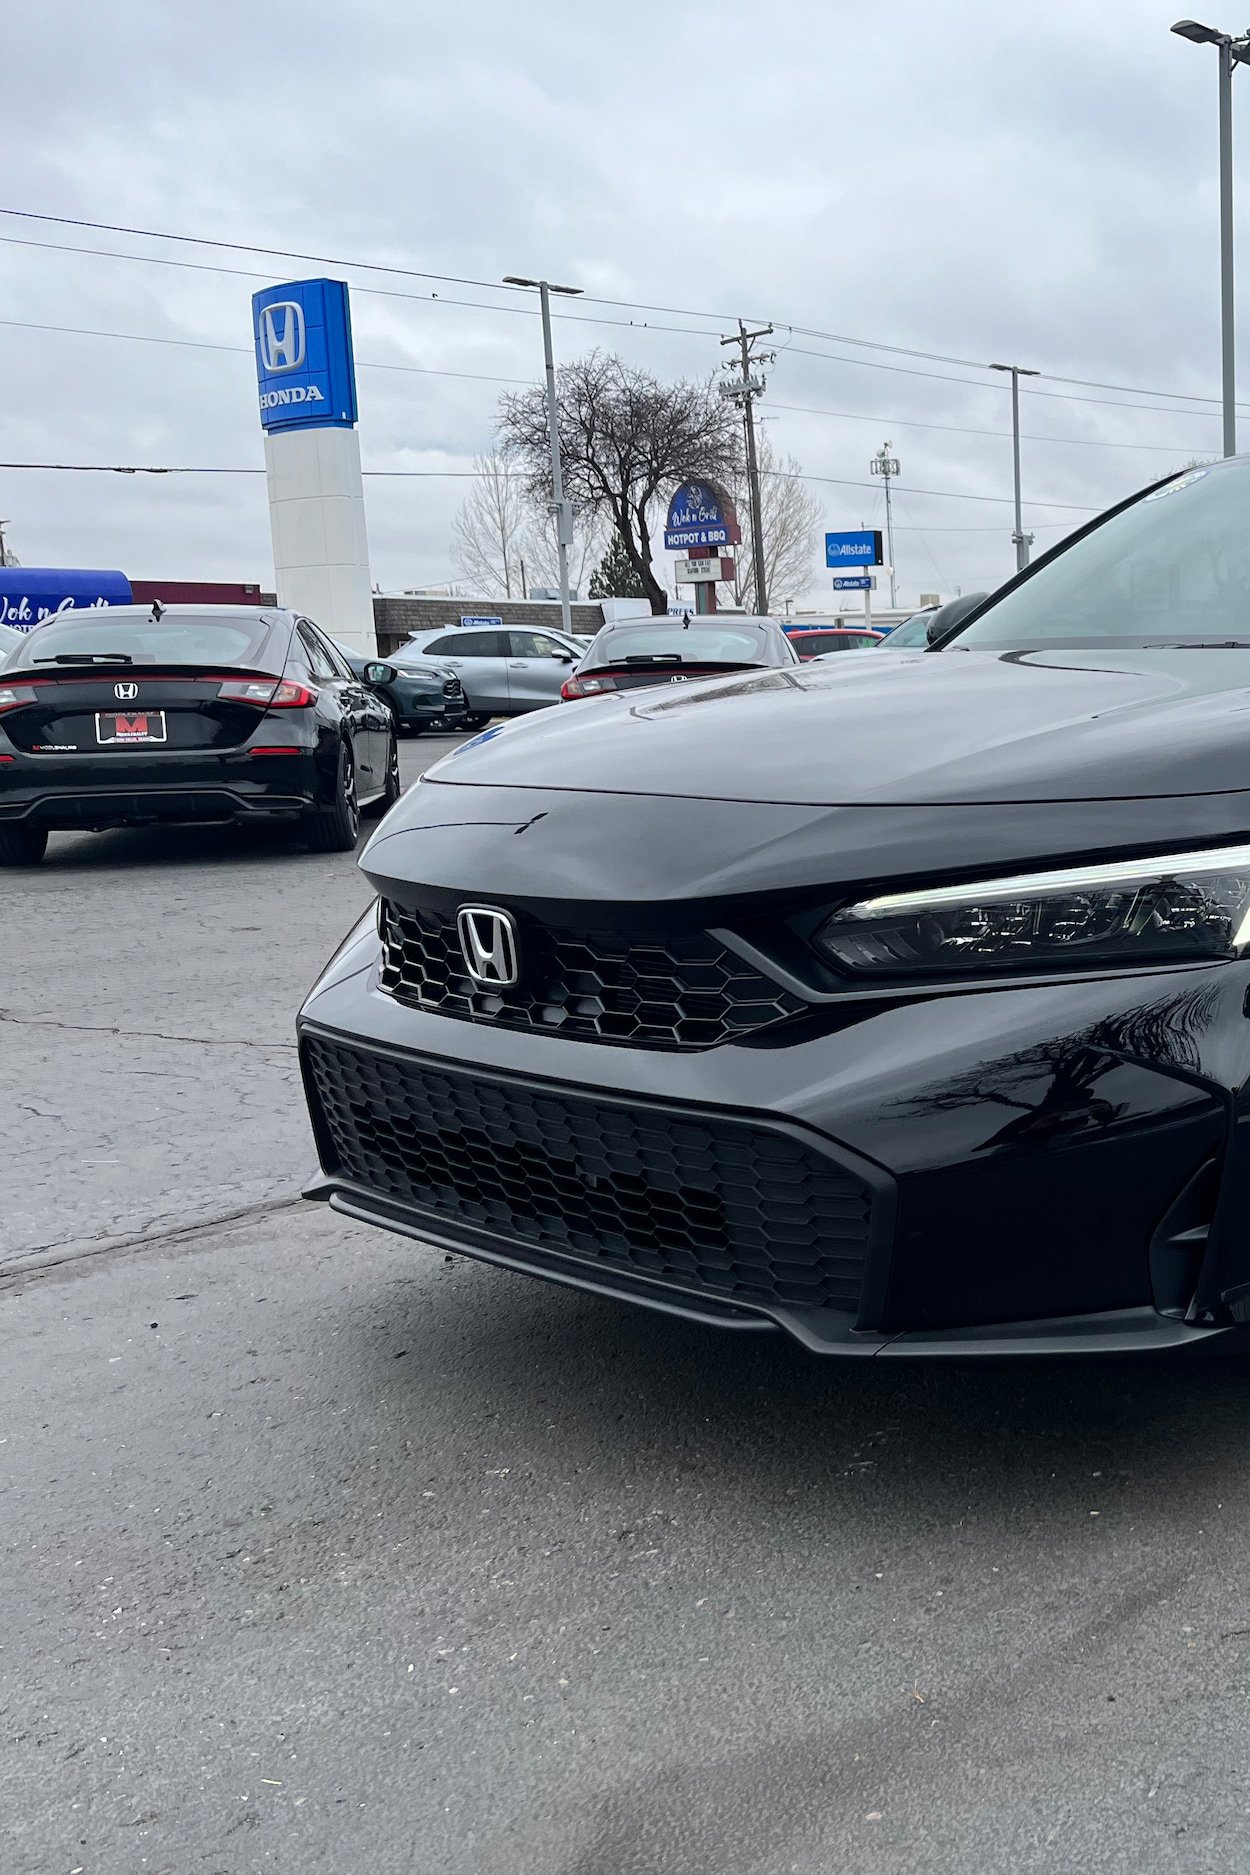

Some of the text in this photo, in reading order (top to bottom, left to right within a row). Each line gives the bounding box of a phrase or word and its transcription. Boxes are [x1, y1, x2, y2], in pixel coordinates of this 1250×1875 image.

[259, 385, 325, 410] HONDA
[668, 530, 726, 546] HOTPOT & BBQ
[839, 543, 872, 556] Allstate
